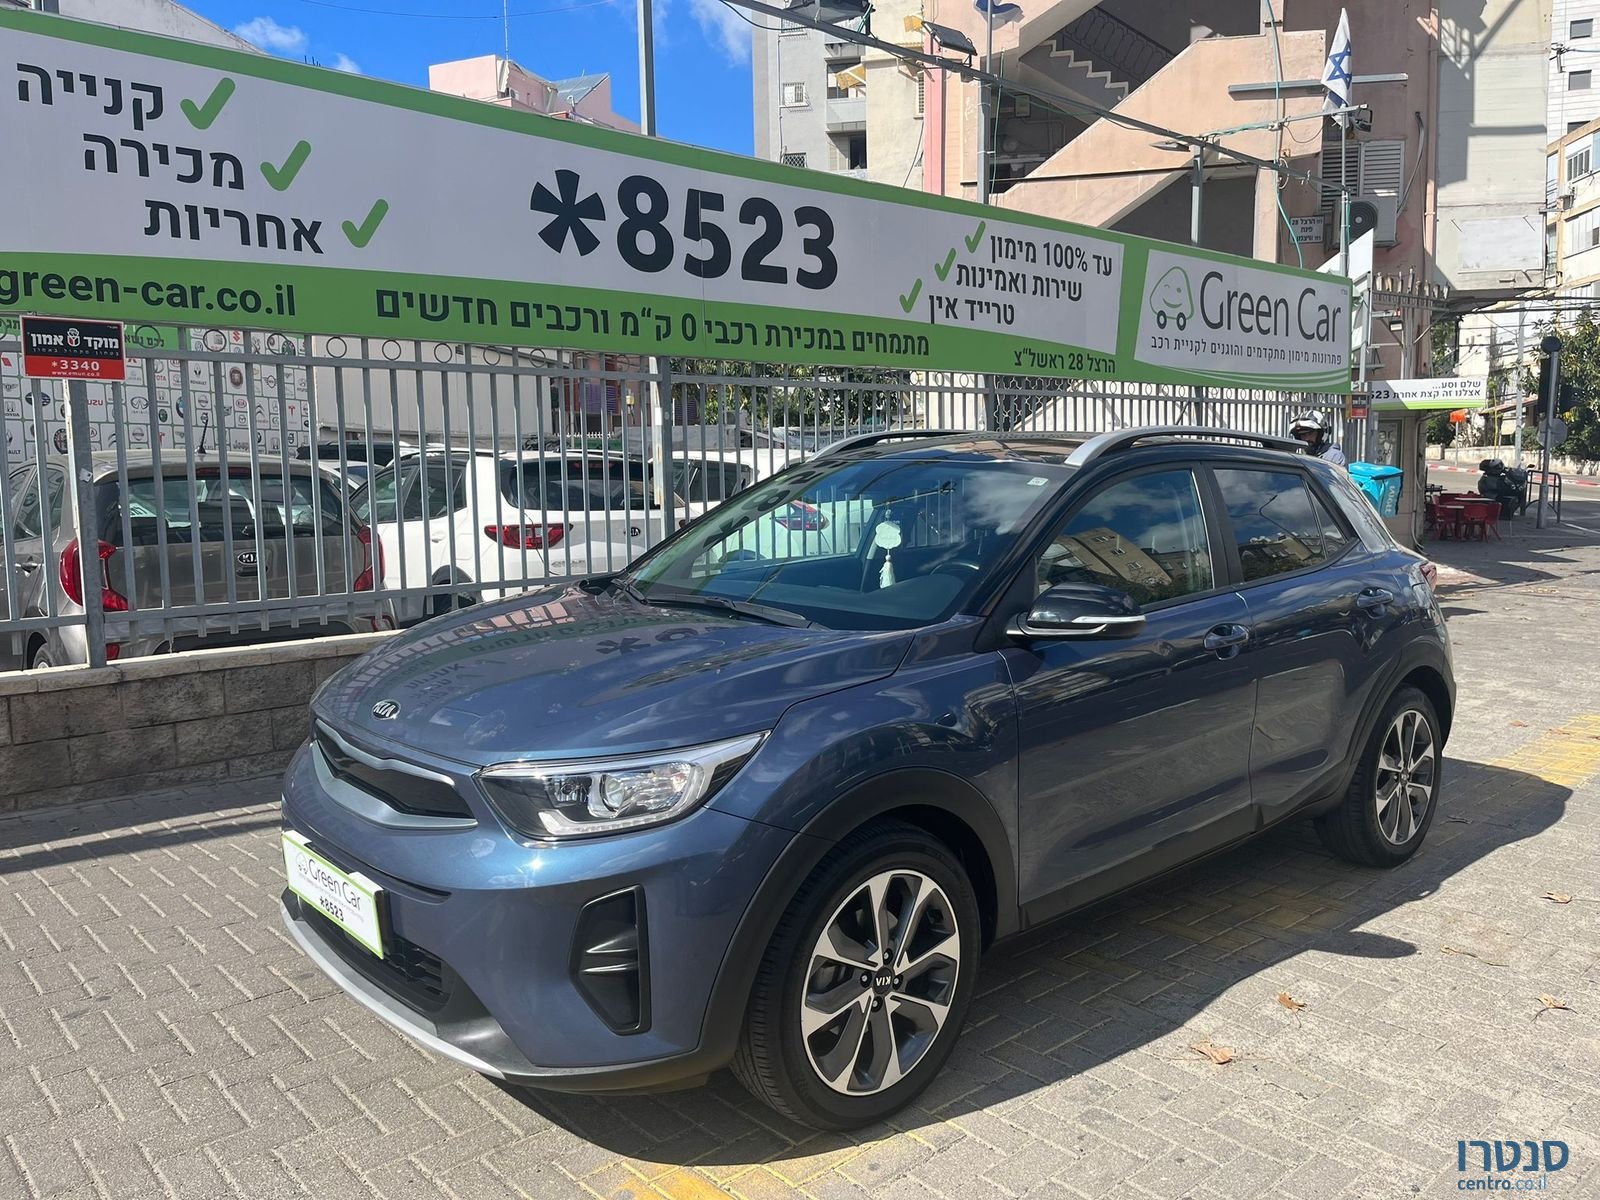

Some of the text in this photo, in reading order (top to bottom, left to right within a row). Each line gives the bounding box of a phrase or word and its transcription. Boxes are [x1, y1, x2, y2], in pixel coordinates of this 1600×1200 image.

[17, 62, 164, 131] קנייה
[83, 133, 244, 190] מכירה
[144, 199, 324, 254] אחריות
[990, 235, 1113, 277] עד 100% מימון
[956, 263, 1083, 302] שירות ואמינות
[376, 289, 498, 328] חדשים
[511, 301, 608, 336] ורכבים
[928, 293, 1015, 326] טרייד אין
[1199, 271, 1342, 343] Green Car
[30, 333, 64, 347] אמון
[682, 312, 697, 341] 0
[705, 317, 758, 346] רכבי
[765, 323, 846, 352] במכירת
[83, 336, 119, 350] מוקד
[853, 327, 930, 358] מתמחים
[1151, 336, 1342, 366] פתרונות מימון מתקדמים והוגנים לקניית רכב
[1068, 352, 1084, 371] 28
[1087, 354, 1116, 374] הרצל
[1392, 391, 1418, 399] אחרת
[1420, 390, 1440, 399] קצת
[1455, 388, 1481, 397] אצלנו
[1460, 379, 1481, 388] שלם
[373, 701, 397, 718] KIA
[308, 858, 361, 912] Green Car
[875, 976, 892, 986] KIA
